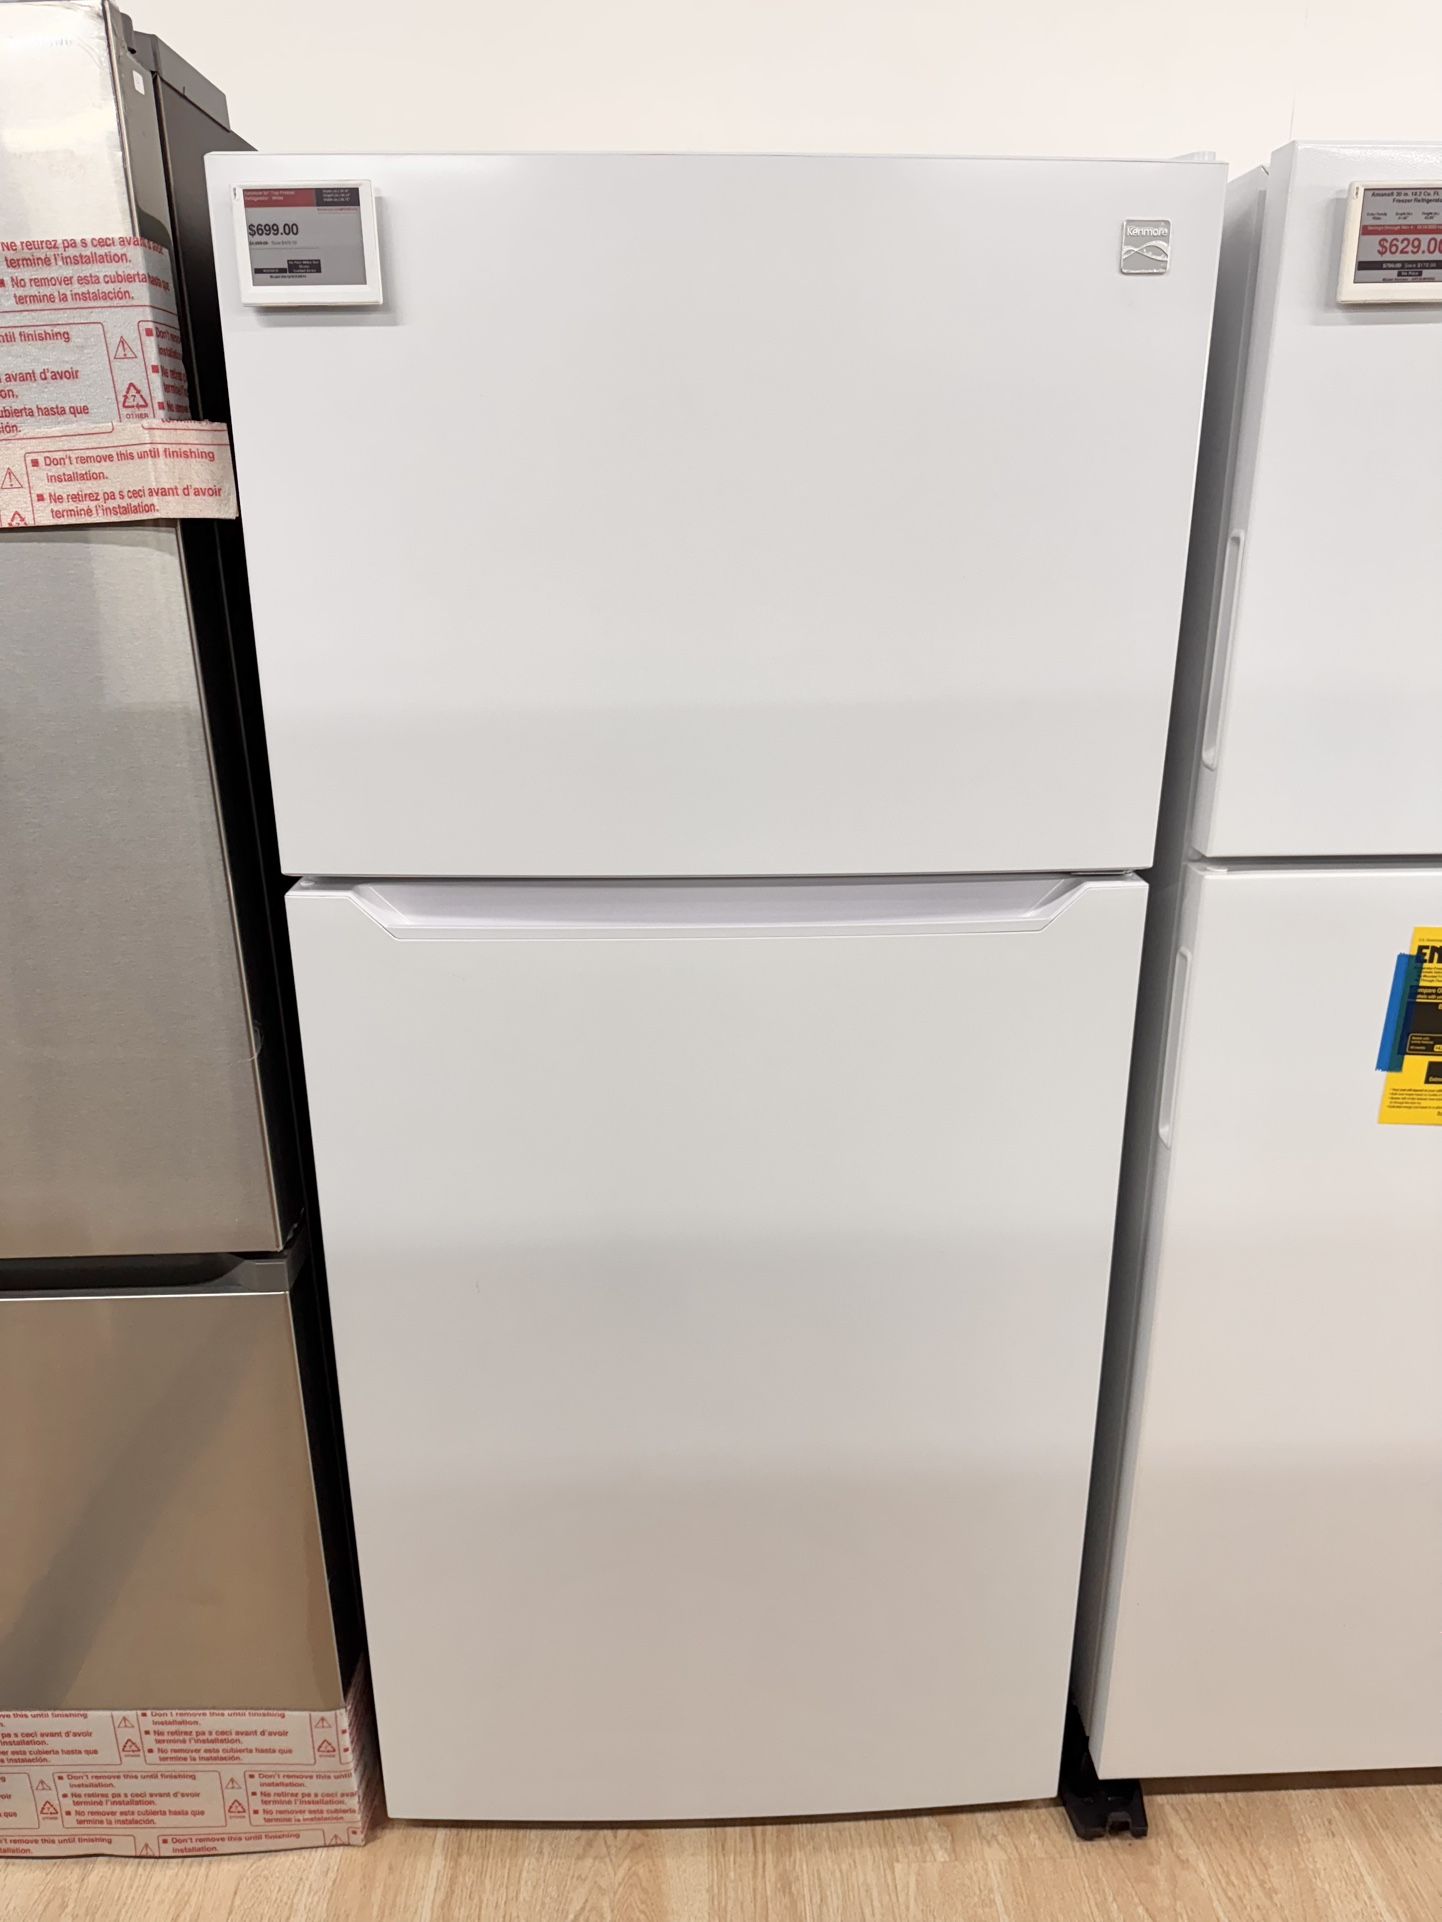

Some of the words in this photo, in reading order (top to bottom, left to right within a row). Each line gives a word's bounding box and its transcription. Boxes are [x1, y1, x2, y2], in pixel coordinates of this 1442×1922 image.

[248, 223, 299, 238] $699.00
[1127, 226, 1168, 237] Kenmore
[62, 238, 77, 252] pa
[80, 237, 88, 248] s
[53, 250, 132, 266] l'installation.
[10, 275, 27, 288] No
[29, 275, 73, 288] remover
[77, 273, 101, 286] esta
[103, 270, 147, 284] cubierta
[13, 290, 56, 305] termine
[57, 290, 68, 302] la
[70, 287, 134, 302] instalación.
[19, 329, 71, 343] finishing
[4, 369, 37, 383] avant
[39, 367, 79, 381] d'avoir
[36, 403, 66, 417] hasta
[69, 404, 90, 418] que
[0, 421, 22, 434] ión.
[43, 454, 73, 467] Don't
[75, 452, 114, 465] remove
[116, 449, 135, 461] this
[136, 447, 160, 460] until
[163, 447, 216, 462] finishing
[48, 491, 64, 504] Ne
[66, 489, 101, 503] retirez
[102, 490, 116, 504] pa
[118, 489, 125, 500] s
[127, 486, 146, 500] ceci
[147, 484, 179, 498] avant
[182, 484, 223, 498] d'avoir
[94, 501, 160, 518] l'installation.
[20, 1730, 38, 1738] ceci
[64, 1730, 93, 1738] d'avoir
[167, 1729, 193, 1737] retirez
[195, 1730, 206, 1738] pa
[215, 1729, 233, 1737] ceci
[234, 1729, 258, 1737] avant
[259, 1729, 289, 1737] d'avoir
[28, 1748, 60, 1756] cubierta
[60, 1748, 82, 1756] hasta
[83, 1749, 99, 1757] que
[221, 1747, 254, 1755] cubierta
[278, 1748, 293, 1756] que
[160, 1772, 197, 1781] finishing
[83, 1791, 109, 1799] retirez
[111, 1792, 122, 1800] pa
[130, 1791, 147, 1799] ceci
[273, 1790, 299, 1798] retirez
[301, 1791, 312, 1799] pa
[320, 1790, 338, 1798] ceci
[74, 1809, 86, 1817] No
[168, 1808, 189, 1816] hasta
[190, 1809, 206, 1817] que
[57, 1836, 76, 1844] until
[77, 1836, 113, 1845] finishing
[171, 1836, 194, 1844] Don't
[244, 1833, 263, 1841] until
